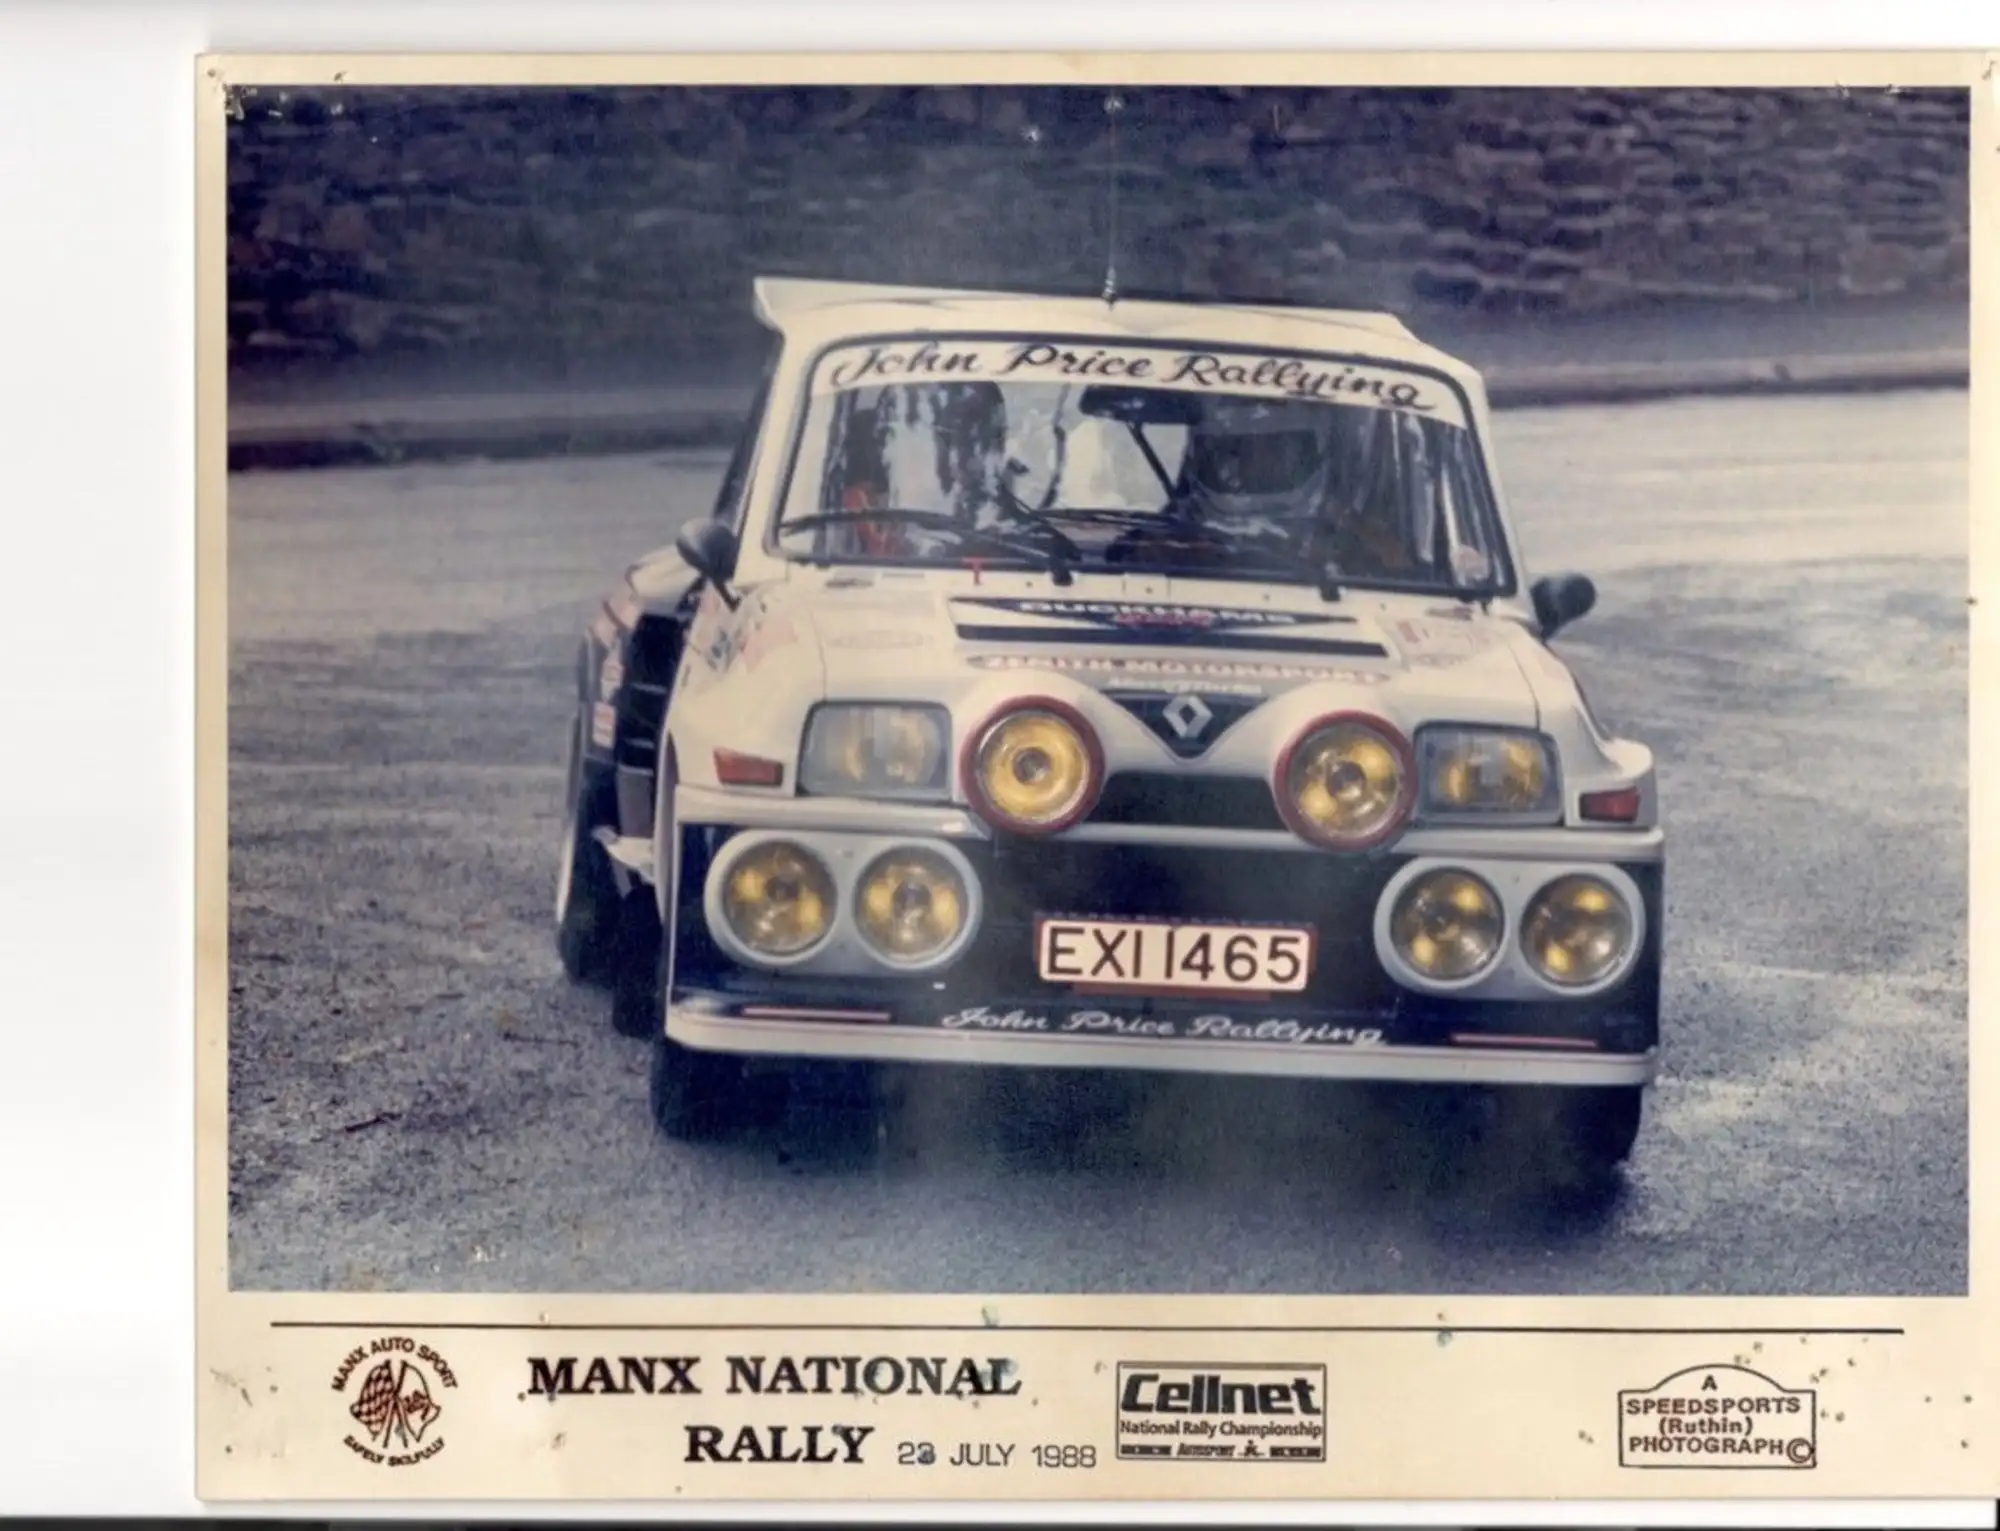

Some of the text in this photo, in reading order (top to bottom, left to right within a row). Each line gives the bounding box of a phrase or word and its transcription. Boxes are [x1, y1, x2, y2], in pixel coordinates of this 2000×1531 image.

[831, 339, 1438, 411] John Price Rallying
[1164, 930, 1302, 984] 1465
[942, 1006, 1389, 1050] John Price Rallying
